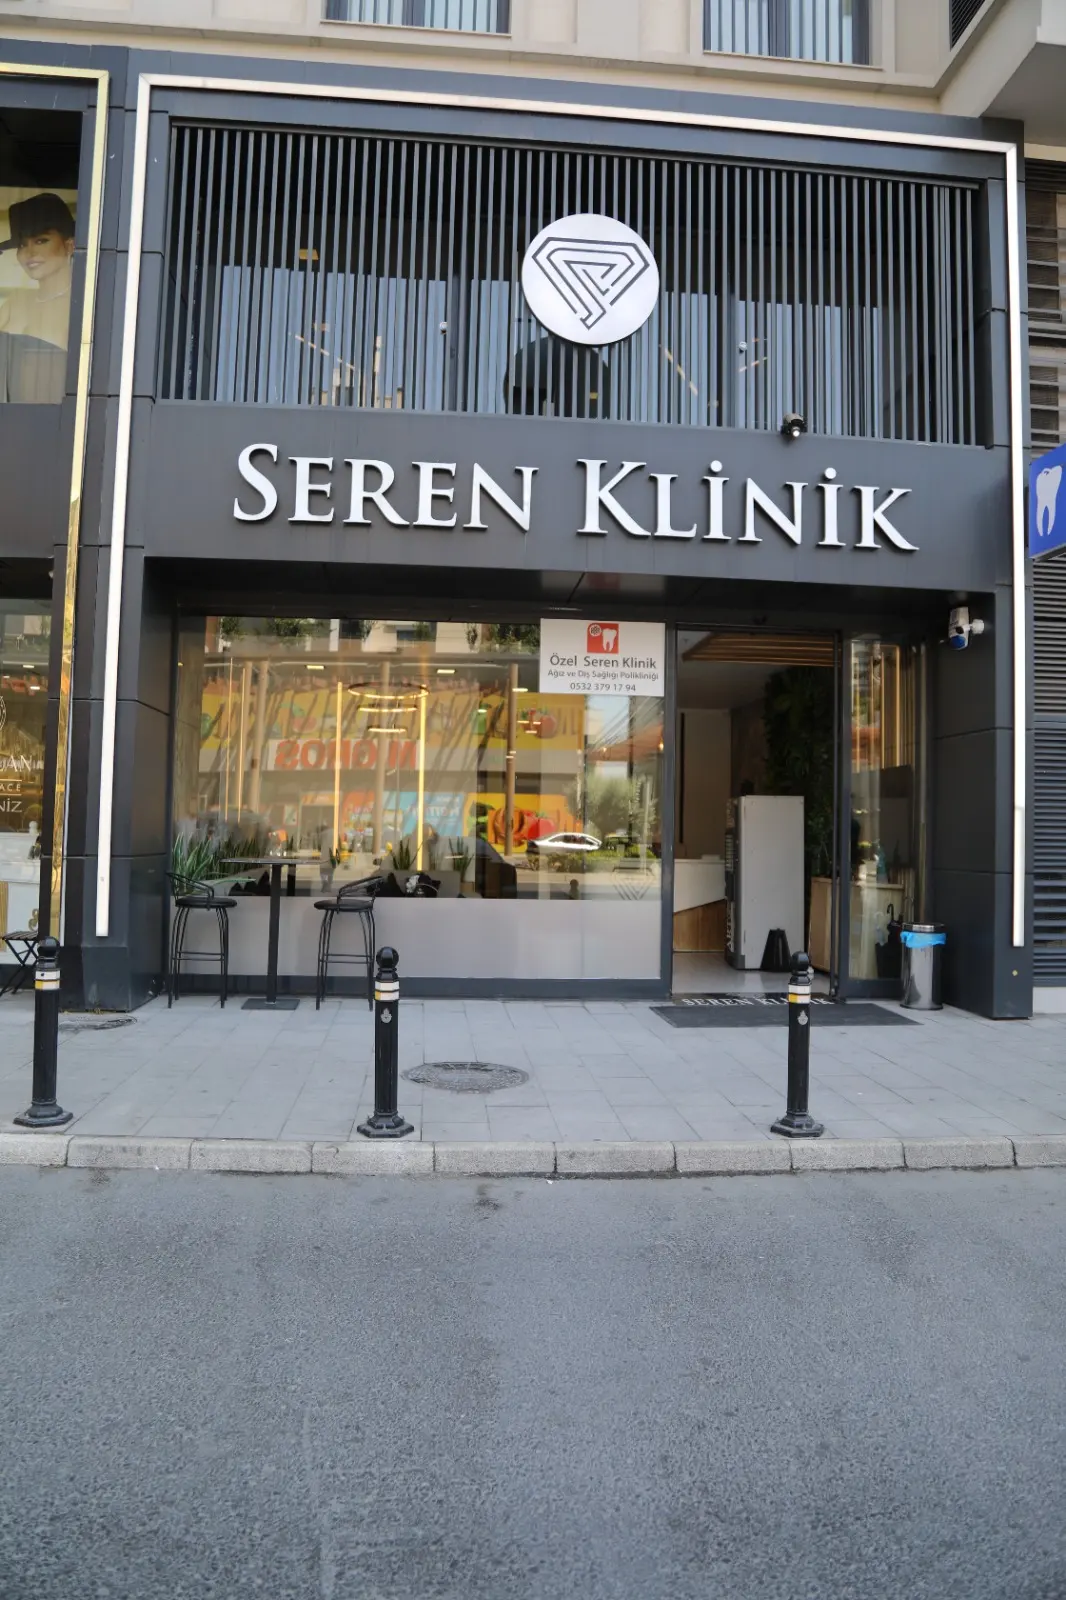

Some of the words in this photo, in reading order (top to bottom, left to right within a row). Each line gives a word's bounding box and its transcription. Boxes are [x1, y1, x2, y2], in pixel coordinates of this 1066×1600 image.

[233, 443, 540, 532] SEREN
[576, 458, 920, 550] KLİNİK
[549, 653, 578, 667] Özel
[583, 656, 619, 668] Seren
[622, 657, 657, 669] Klinik
[547, 669, 566, 679] Ağız
[577, 670, 590, 680] Diş
[591, 670, 619, 680] Sağlığı
[620, 671, 659, 681] Polikliniği
[570, 682, 592, 691] 0532
[594, 683, 611, 692] 379
[613, 683, 625, 692] 17
[625, 684, 637, 692] 94
